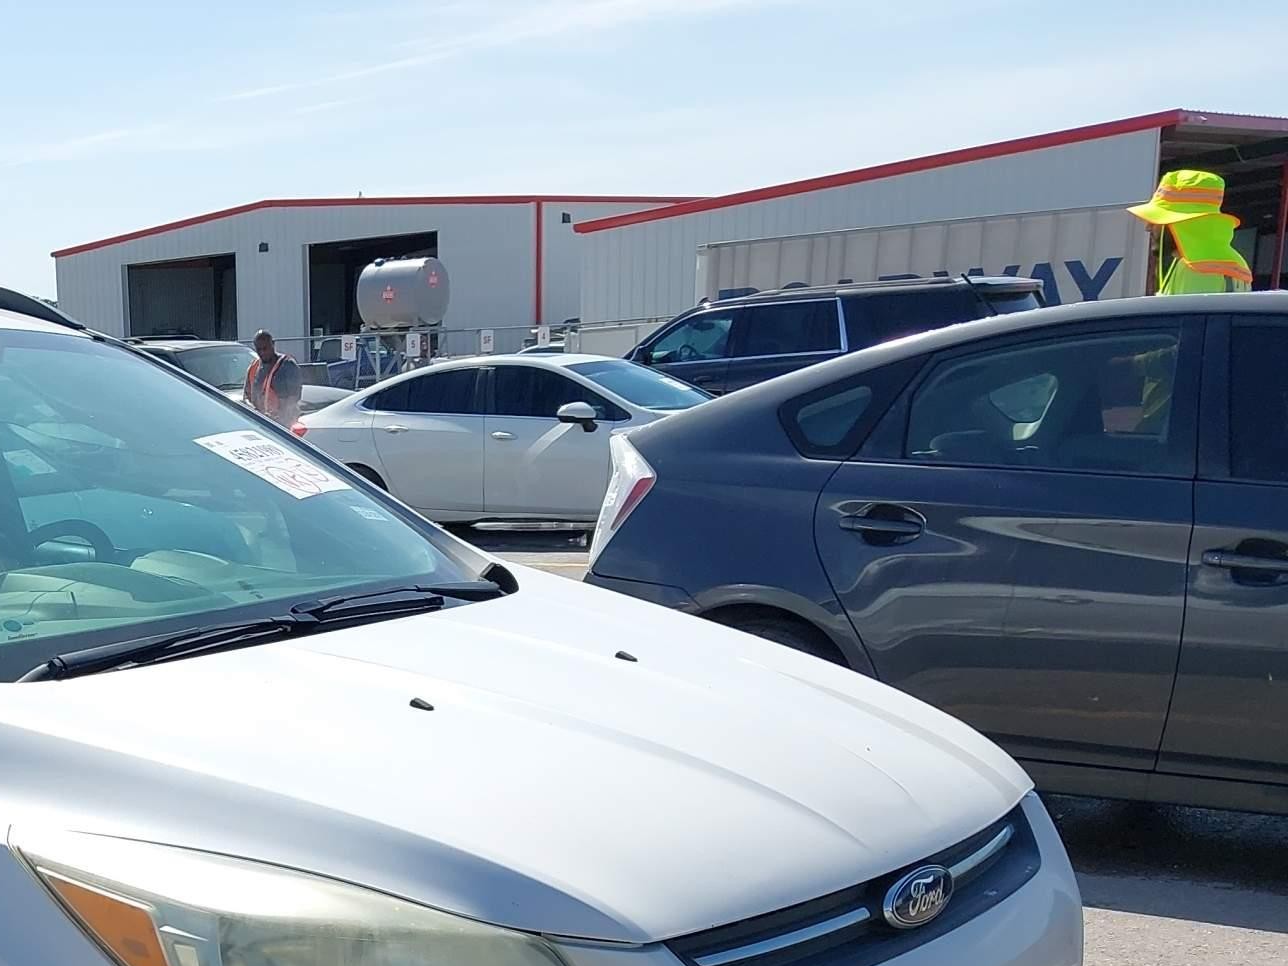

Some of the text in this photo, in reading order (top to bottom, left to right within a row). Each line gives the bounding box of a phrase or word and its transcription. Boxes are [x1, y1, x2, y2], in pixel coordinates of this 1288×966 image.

[483, 335, 492, 344] SF
[344, 342, 354, 351] SF
[909, 875, 948, 916] Ford
